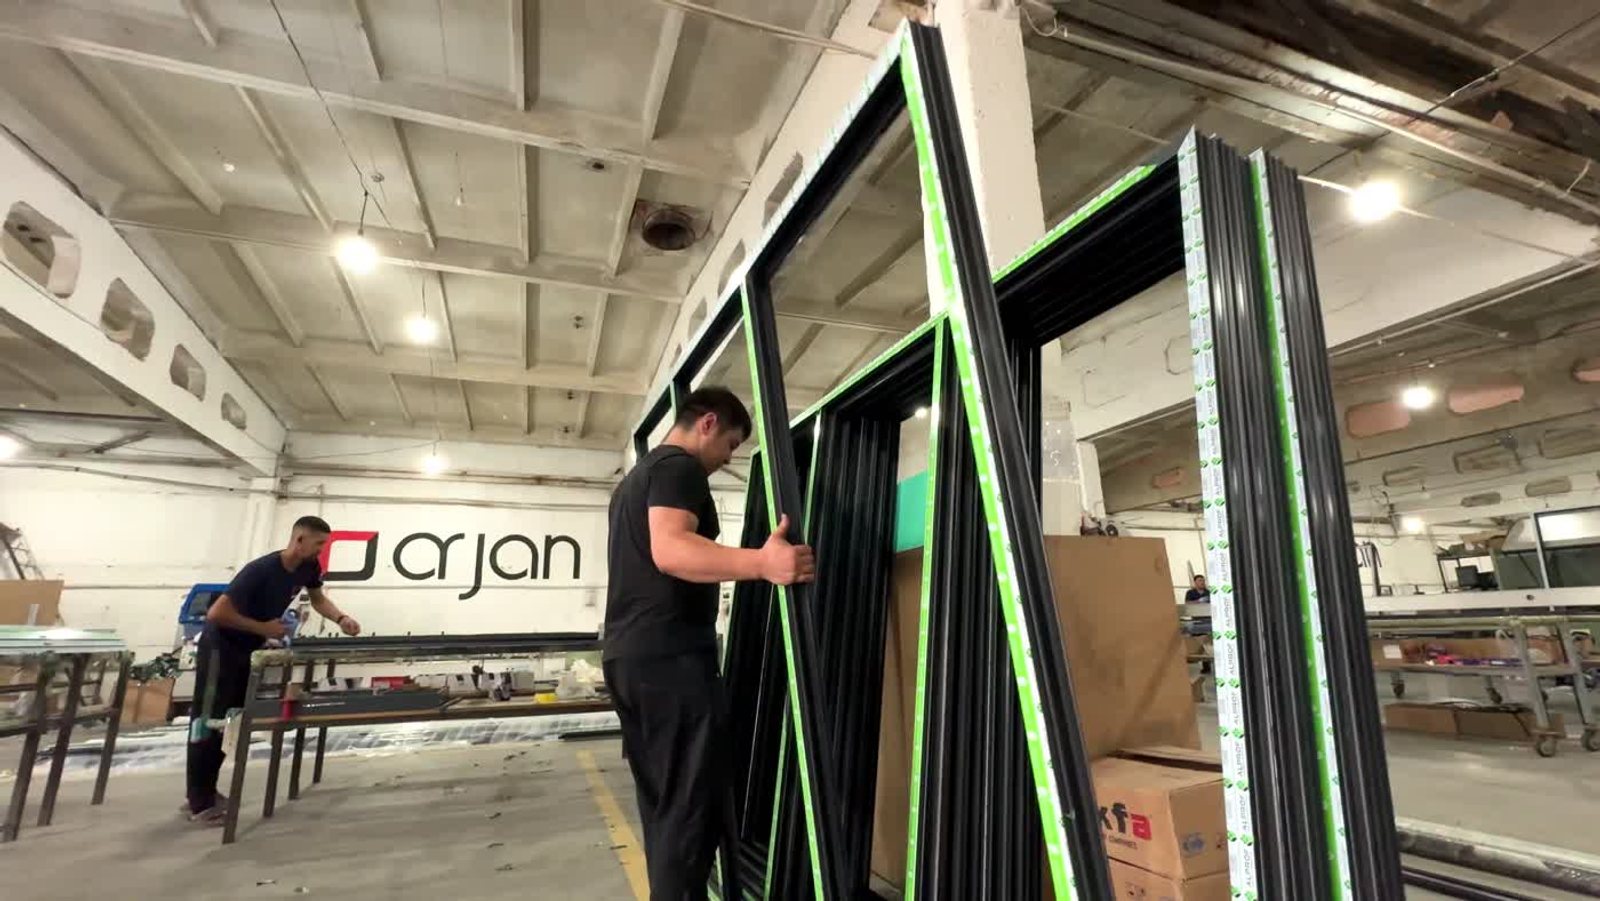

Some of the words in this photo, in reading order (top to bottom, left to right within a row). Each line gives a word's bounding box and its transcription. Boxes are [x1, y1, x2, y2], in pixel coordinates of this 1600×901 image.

[393, 532, 581, 600] arjan
[1235, 740, 1243, 777] ALPROF
[1240, 795, 1248, 831] ALPROF
[1244, 848, 1252, 887] ALPROF
